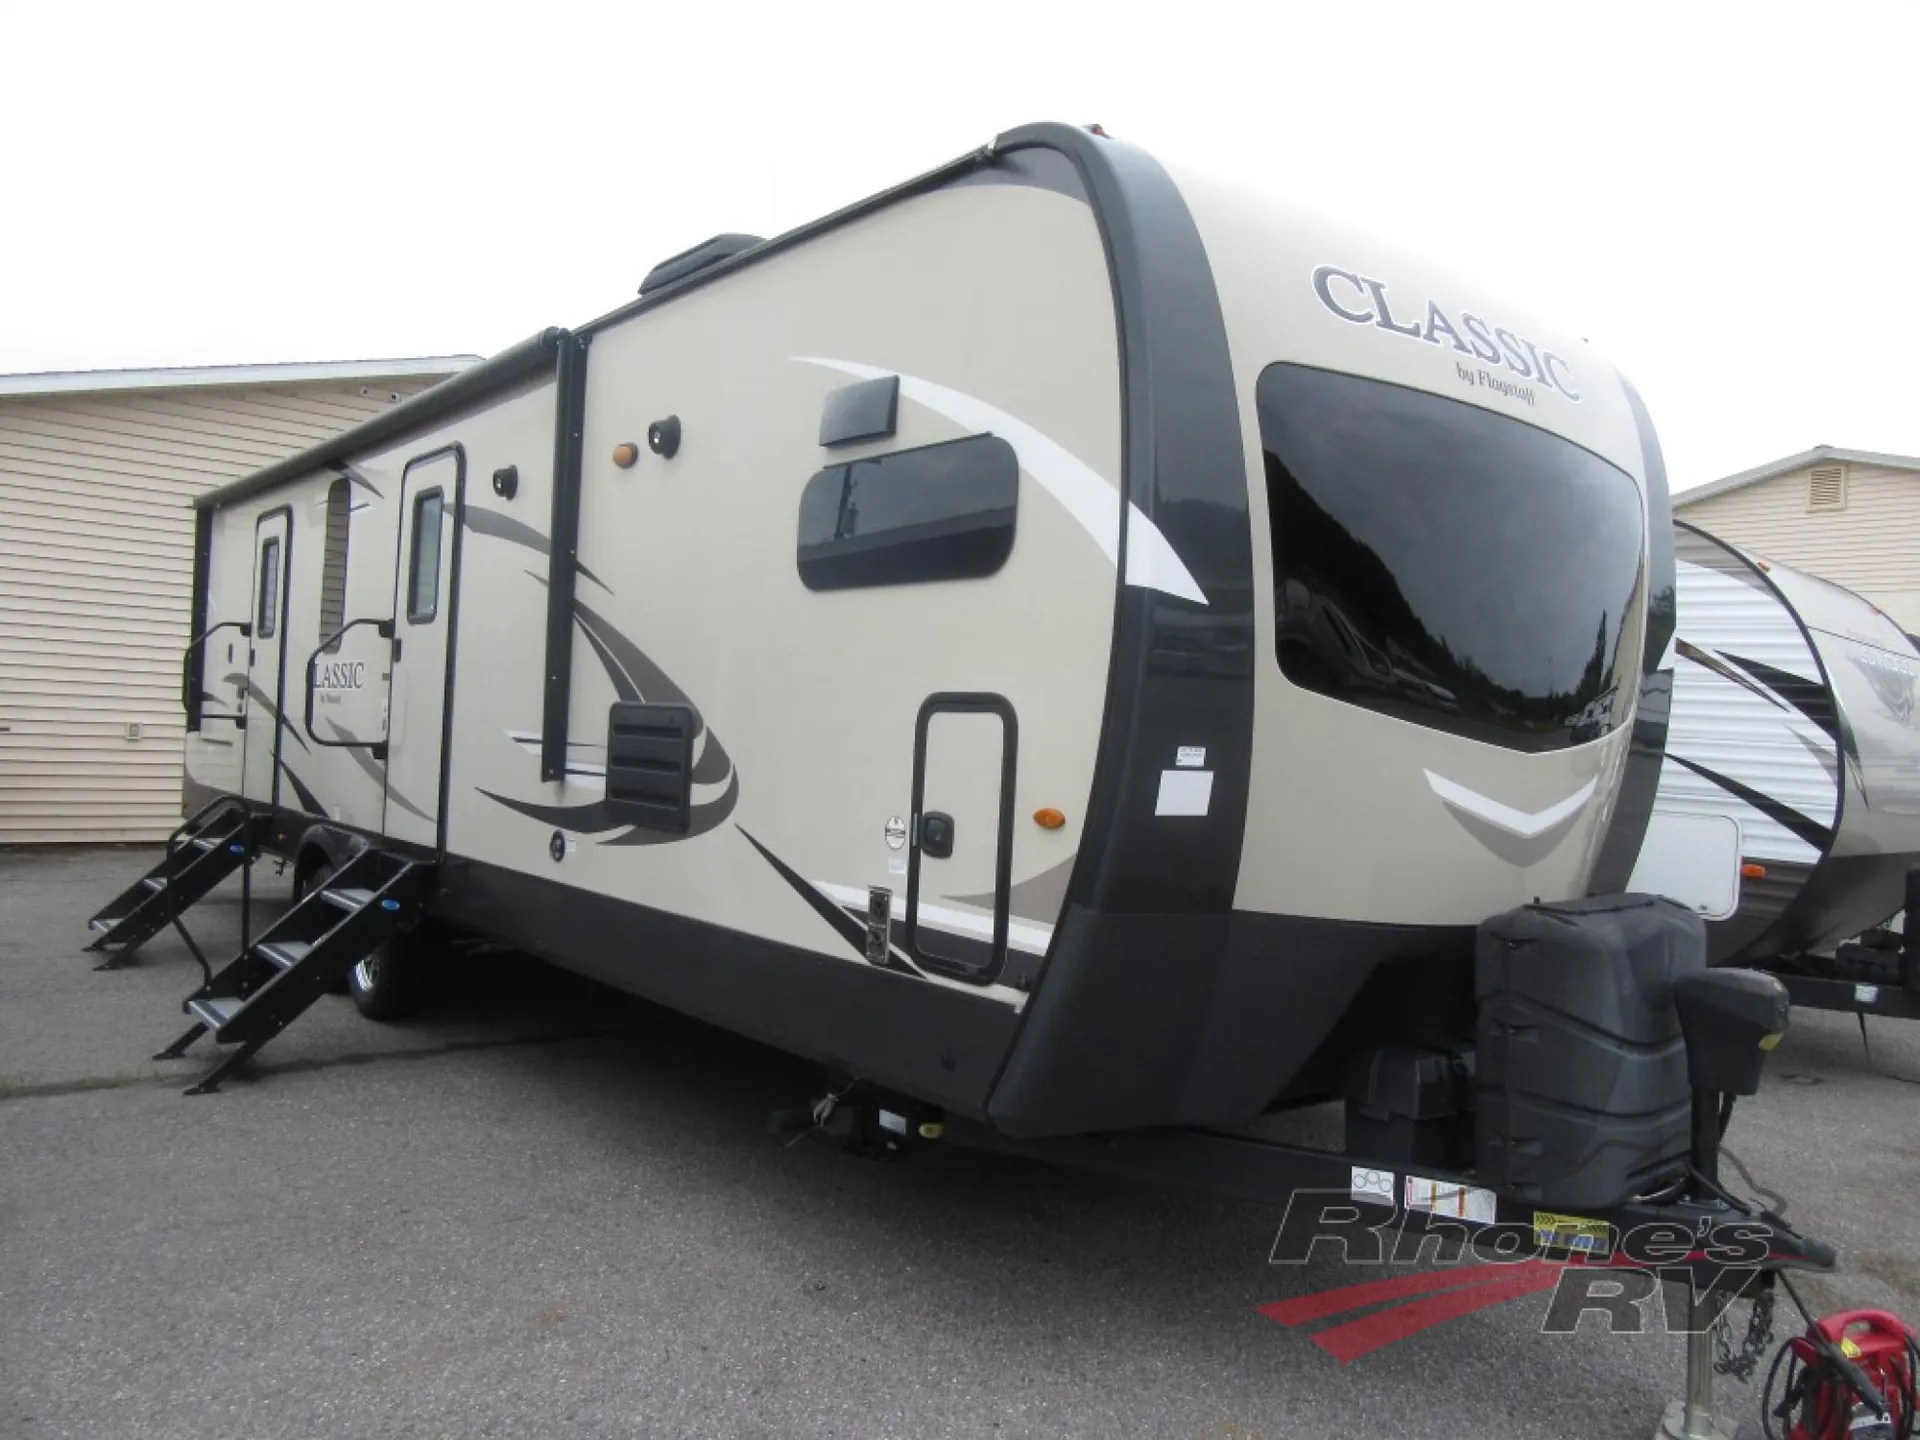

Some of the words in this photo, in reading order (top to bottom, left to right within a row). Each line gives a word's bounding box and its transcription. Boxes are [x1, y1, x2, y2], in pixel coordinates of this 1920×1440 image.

[1311, 264, 1580, 402] CLASSIC
[1455, 361, 1475, 386] by
[1477, 368, 1535, 407] Flagstaff
[307, 660, 365, 689] LASSIC
